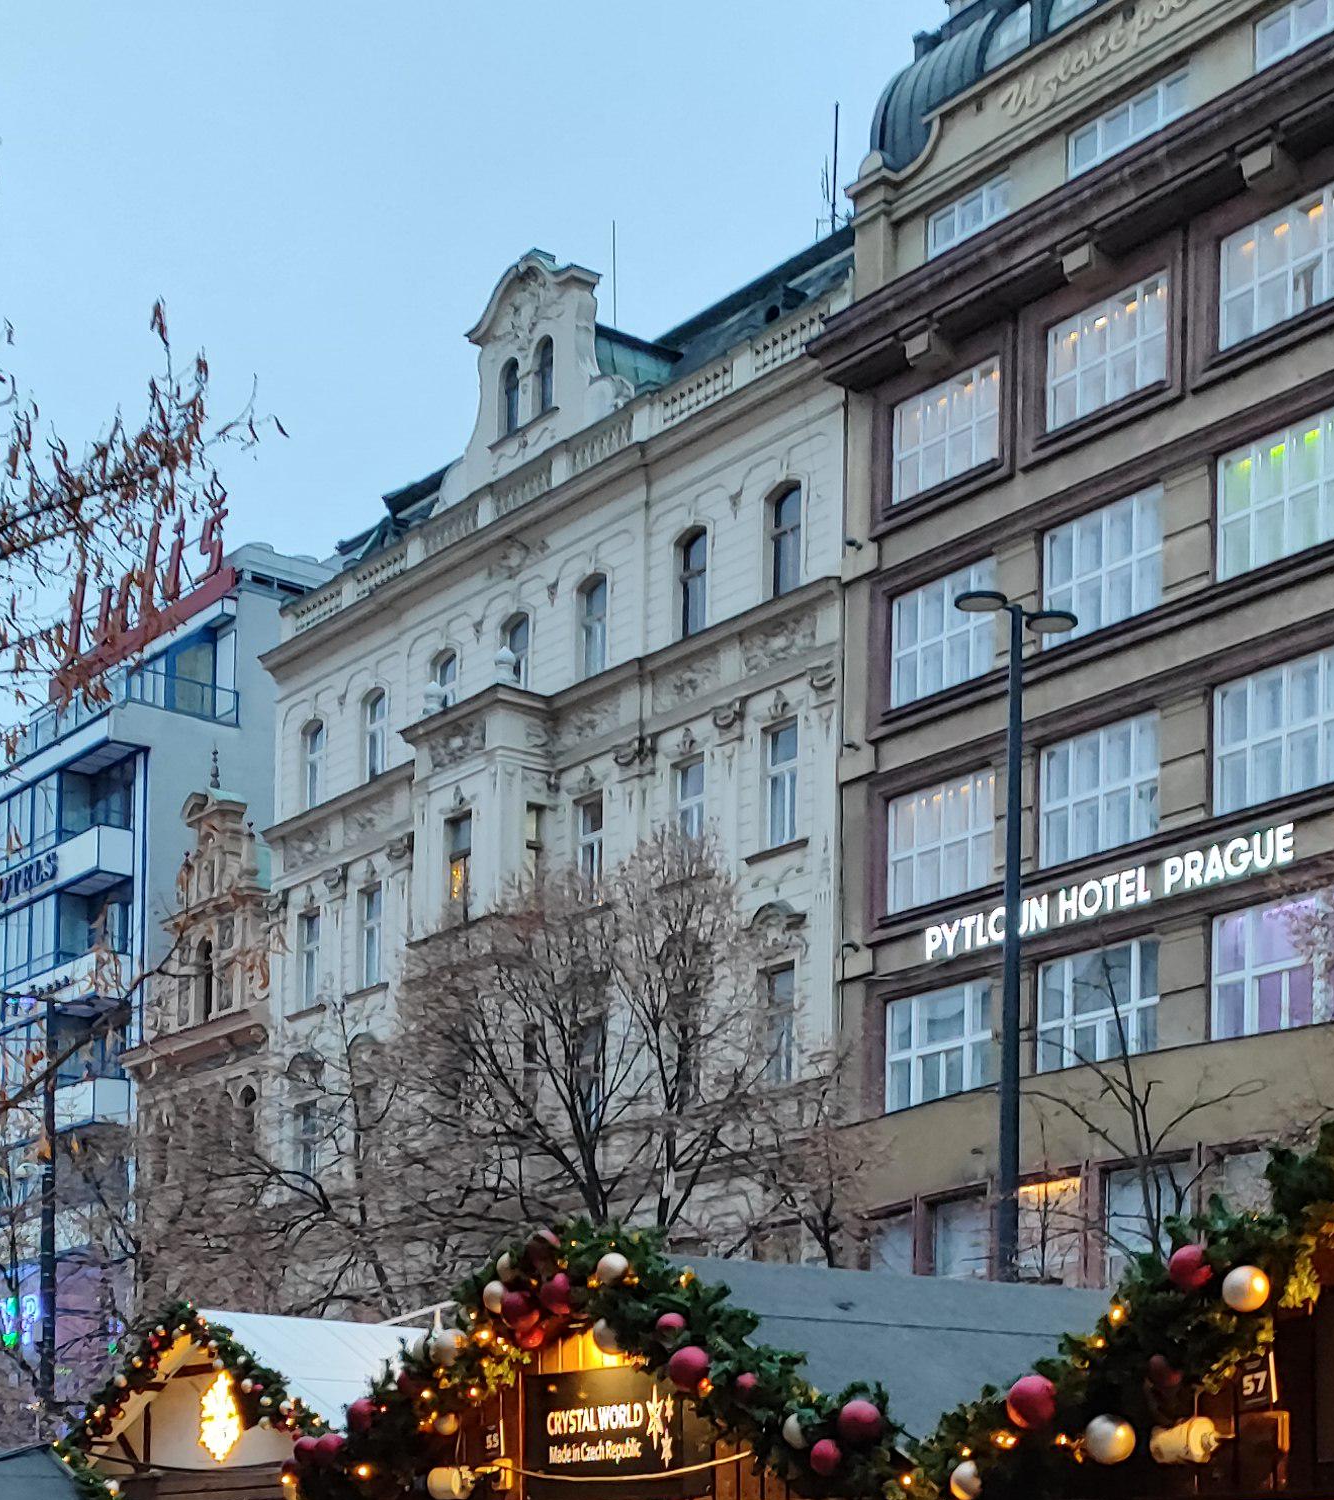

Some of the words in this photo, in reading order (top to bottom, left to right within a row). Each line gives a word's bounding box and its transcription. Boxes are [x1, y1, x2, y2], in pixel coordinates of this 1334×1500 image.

[1059, 866, 1151, 925] HOTEL
[1164, 822, 1295, 895] PRAGUE
[1242, 1370, 1267, 1396] 57
[547, 1406, 598, 1436] CRYSTAL
[598, 1402, 643, 1432] WORLD
[549, 1444, 571, 1464] Made
[581, 1440, 605, 1462] Czech
[605, 1437, 643, 1465] Republic
